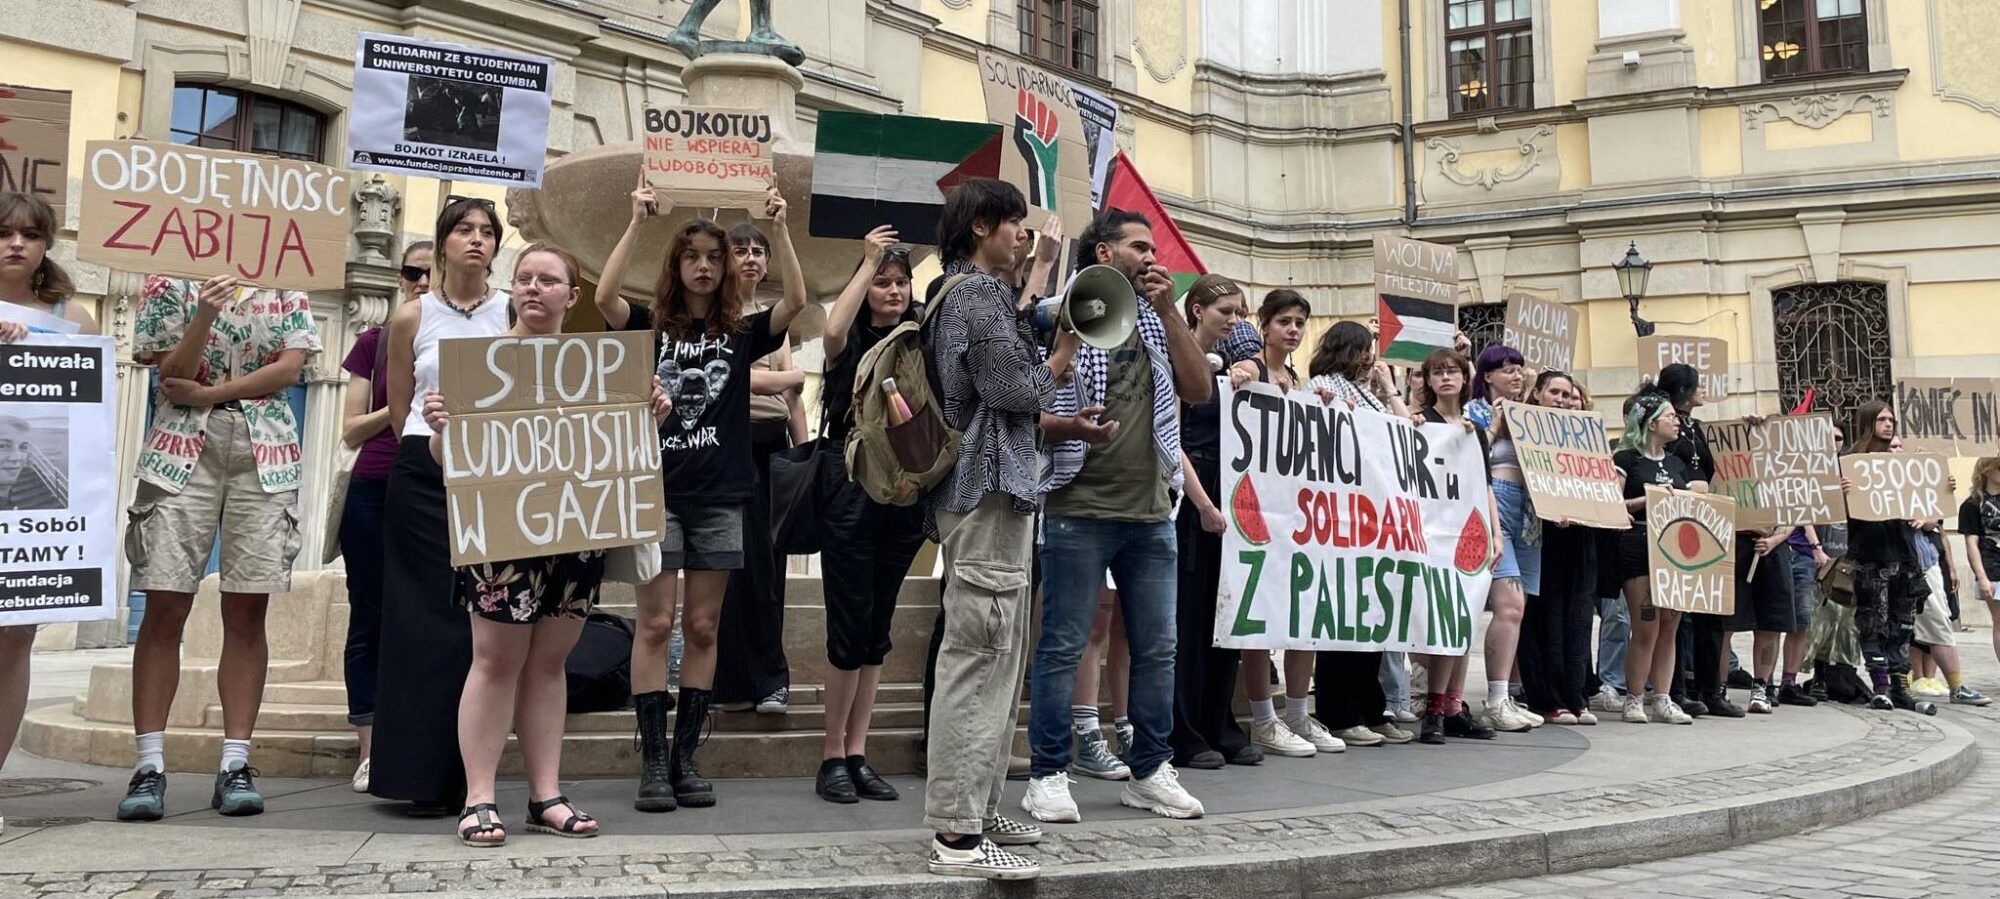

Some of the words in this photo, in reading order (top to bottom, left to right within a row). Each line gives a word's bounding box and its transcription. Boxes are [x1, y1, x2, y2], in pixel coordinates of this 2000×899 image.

[372, 43, 441, 61] SOLIDARNI
[444, 52, 460, 64] ZE
[463, 55, 540, 75] STUDENTAMI
[373, 58, 473, 79] UNIWERSYTETU
[476, 71, 538, 89] COLUMBIA
[645, 108, 772, 143] BOJKOTUJ
[394, 143, 444, 158] BOJKOT
[448, 150, 499, 164] IZRAELA
[646, 137, 674, 151] NIE
[687, 139, 760, 158] WSPIERAJ
[91, 145, 346, 216] OBOJĘTNOŚĆ
[378, 156, 522, 179] www.fundacjaprzebudzenie.pl
[648, 158, 772, 179] LUDOBÓJSTWA
[102, 200, 315, 279] ZABIJA
[1382, 238, 1453, 277] WOLNA
[1384, 269, 1451, 299] PALESTYNA
[1517, 296, 1569, 340] WOLNA
[8, 351, 96, 370] chwała
[1502, 327, 1572, 373] PALESTYNA
[1657, 341, 1711, 371] FREE
[0, 383, 63, 397] erom
[475, 338, 625, 409] STOP
[1897, 380, 1967, 440] KONIEC
[442, 405, 662, 481] LUDOBÓJSTWU
[687, 426, 721, 451] WAR
[1231, 389, 1363, 486] STUDENCI
[1508, 406, 1608, 454] SOLIDARITY
[1519, 445, 1554, 473] WITH
[1555, 452, 1618, 481] STUDENTS
[1854, 457, 1942, 491] 35000
[1527, 470, 1623, 503] ENCAMPMENTS
[1869, 488, 1944, 517] OFIAR
[18, 515, 86, 533] Soból
[452, 491, 486, 556] W
[516, 475, 657, 545] GAZIE
[1291, 487, 1428, 555] SOLIDARNI
[1776, 505, 1831, 525] LIZM
[0, 545, 69, 564] TAMY
[1231, 550, 1266, 636] Z
[1656, 568, 1724, 612] RAFAH
